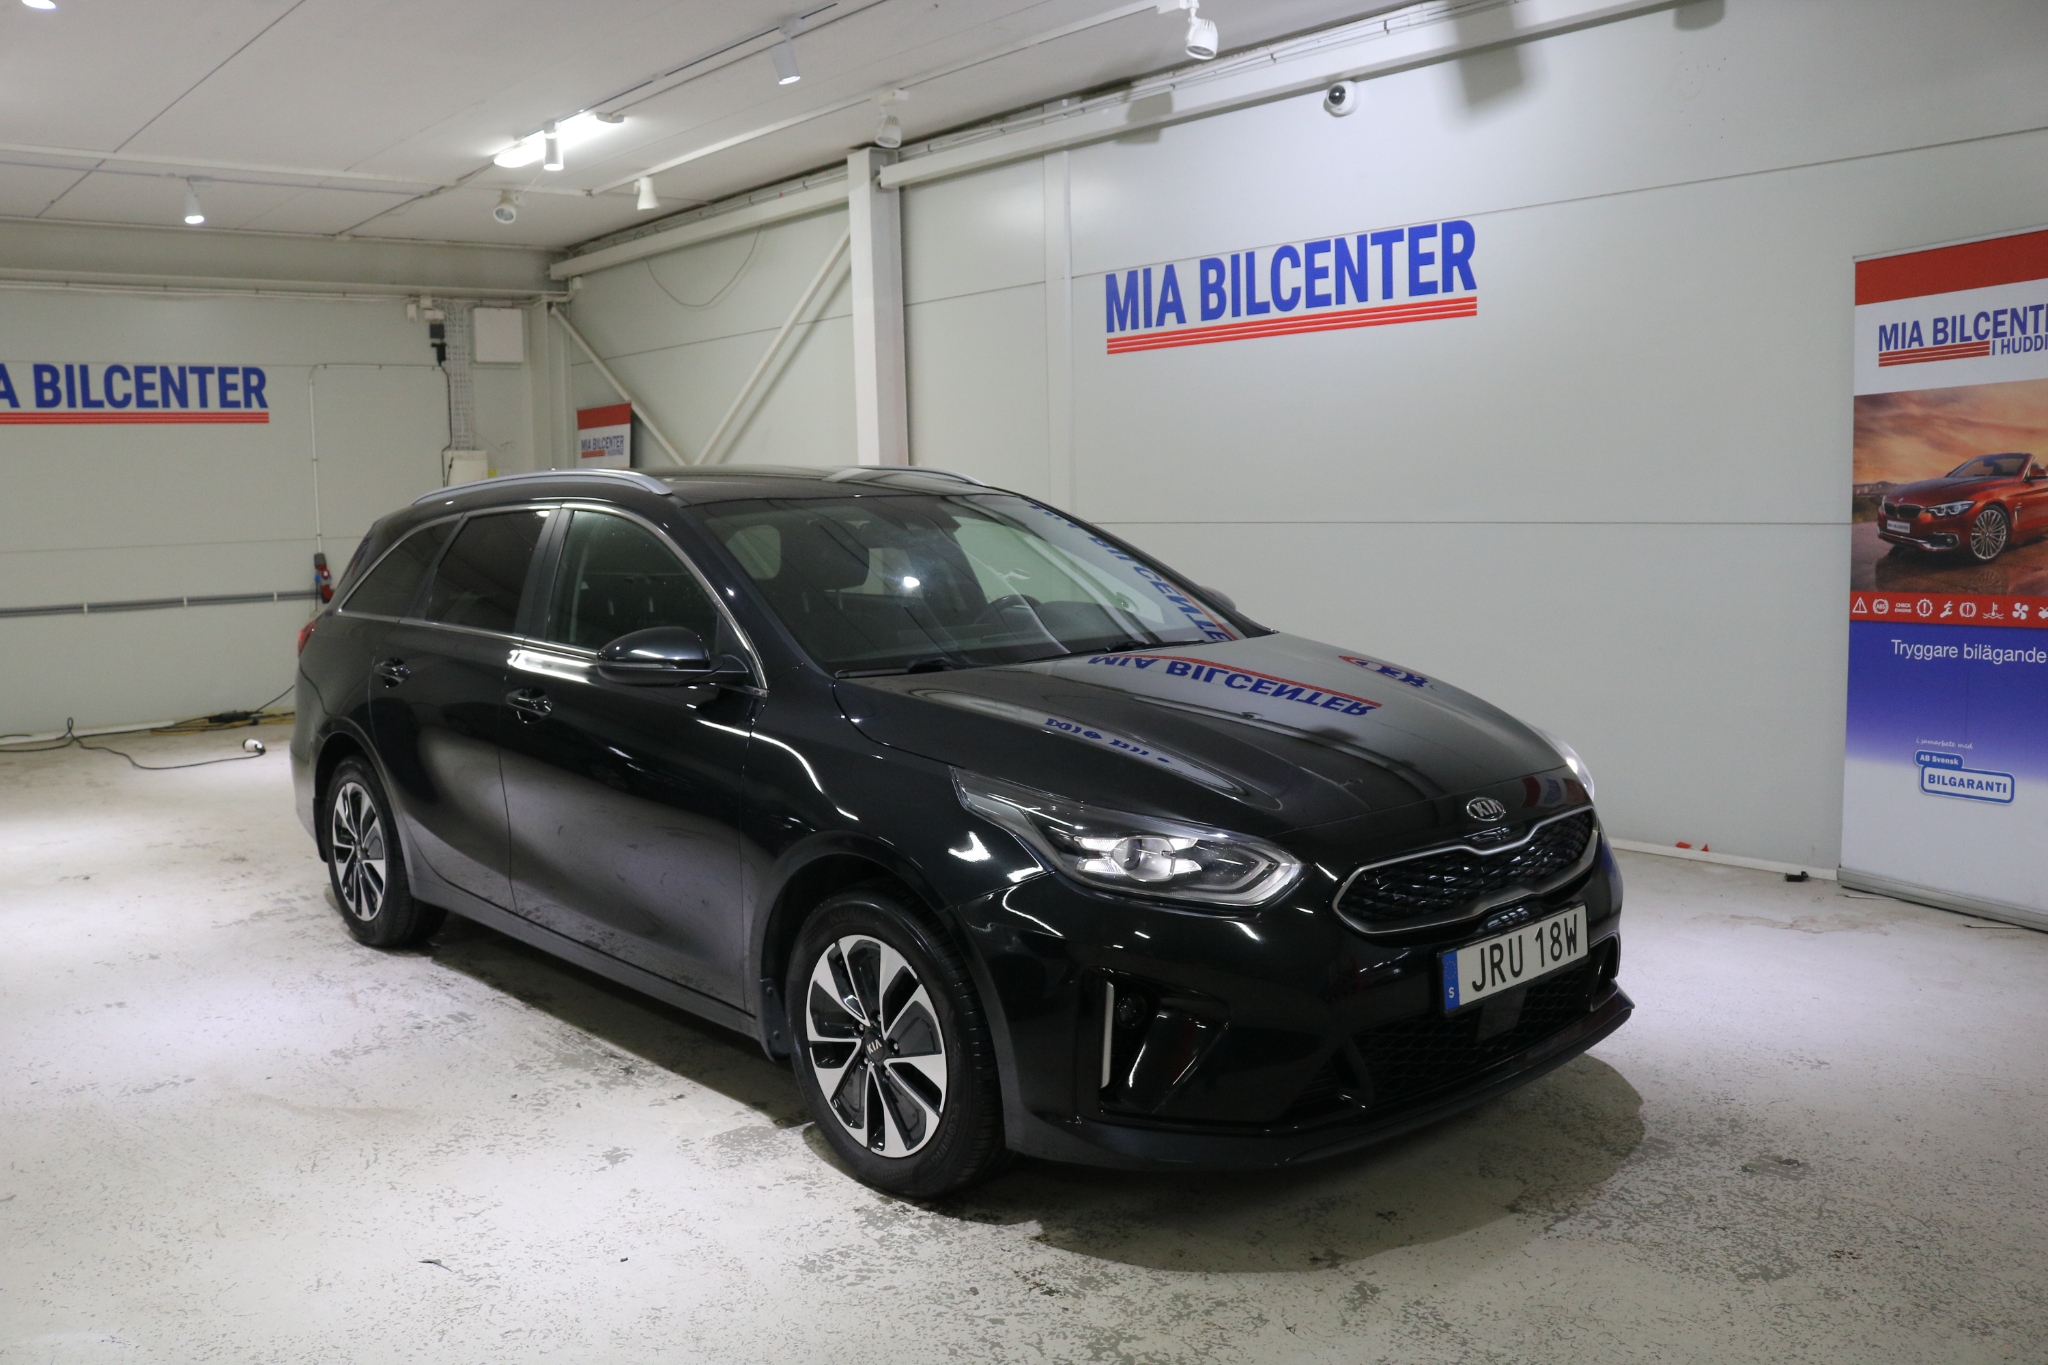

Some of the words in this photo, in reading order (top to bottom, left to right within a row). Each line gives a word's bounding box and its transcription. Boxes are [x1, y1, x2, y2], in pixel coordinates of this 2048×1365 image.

[1105, 263, 1187, 333] MIA
[1200, 219, 1477, 322] BILCENTER
[1878, 320, 1924, 352] MIA
[1933, 303, 2048, 346] BILCENT
[33, 363, 269, 409] BILCENTER
[1891, 639, 1958, 661] Tryggare
[1963, 643, 2047, 665] bilägande
[1920, 754, 1930, 762] AB
[1932, 755, 1959, 766] Svensk
[1928, 774, 2007, 793] BILGARANTI
[1471, 799, 1502, 817] KIA
[1472, 934, 1523, 993] JRU
[1535, 913, 1577, 968] 18W
[1448, 987, 1455, 999] S
[866, 1039, 883, 1054] KIA
